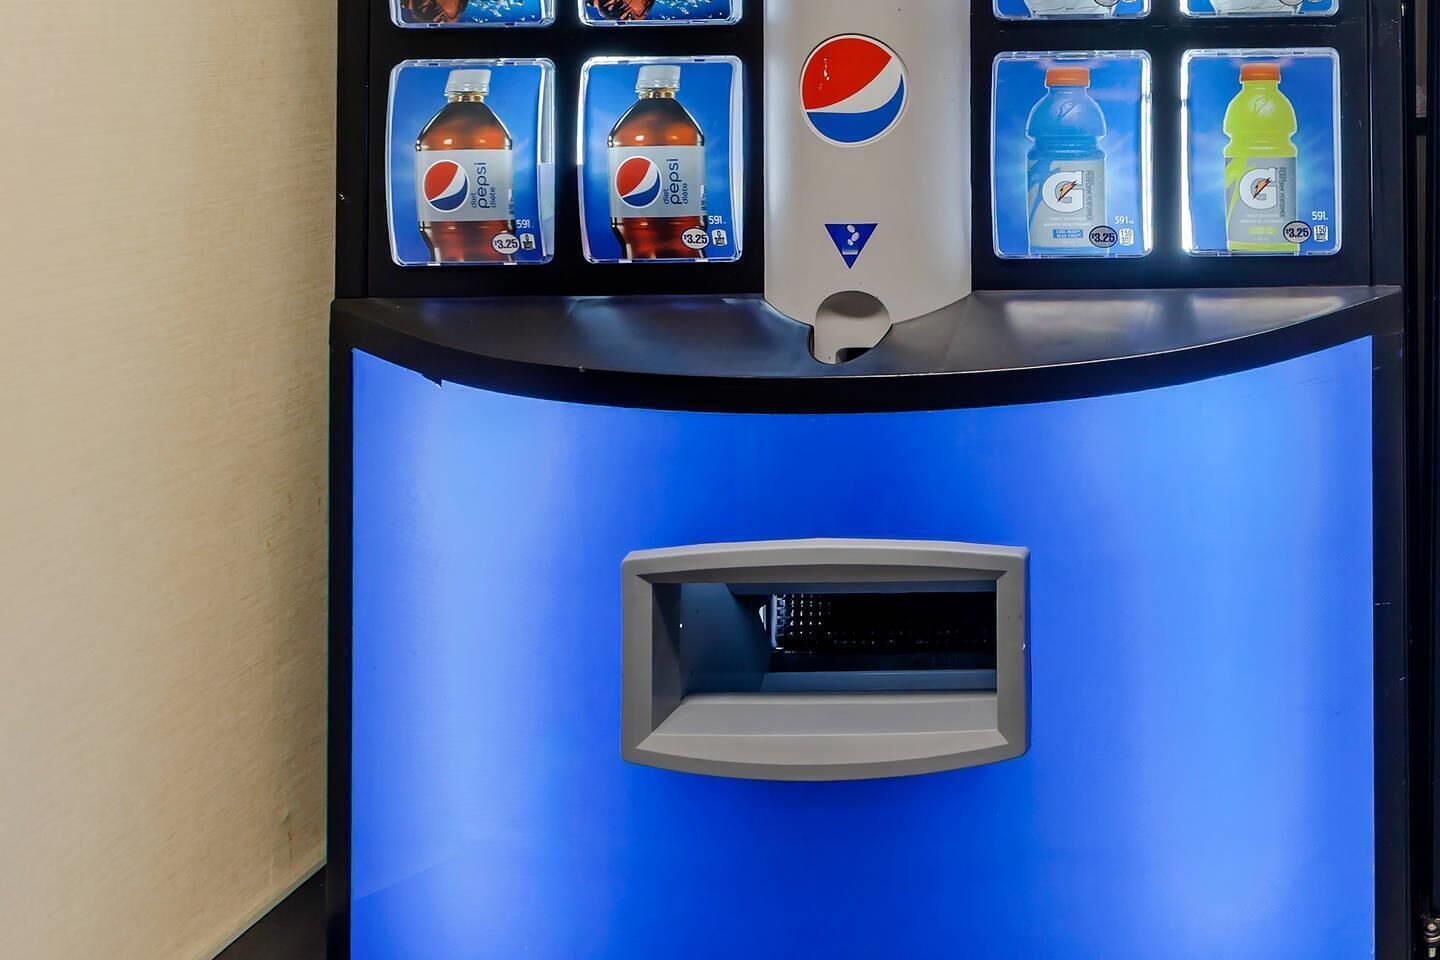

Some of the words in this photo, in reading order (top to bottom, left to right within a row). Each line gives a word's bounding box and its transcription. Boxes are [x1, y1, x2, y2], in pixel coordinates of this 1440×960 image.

[474, 162, 491, 209] pepsi
[666, 158, 683, 205] pepsi
[1042, 171, 1083, 212] G
[1239, 168, 1277, 210] G
[494, 239, 518, 249] $3.25
[683, 234, 708, 244] $3.25
[1091, 232, 1115, 243] $3.25
[1285, 228, 1309, 238] $3.25
